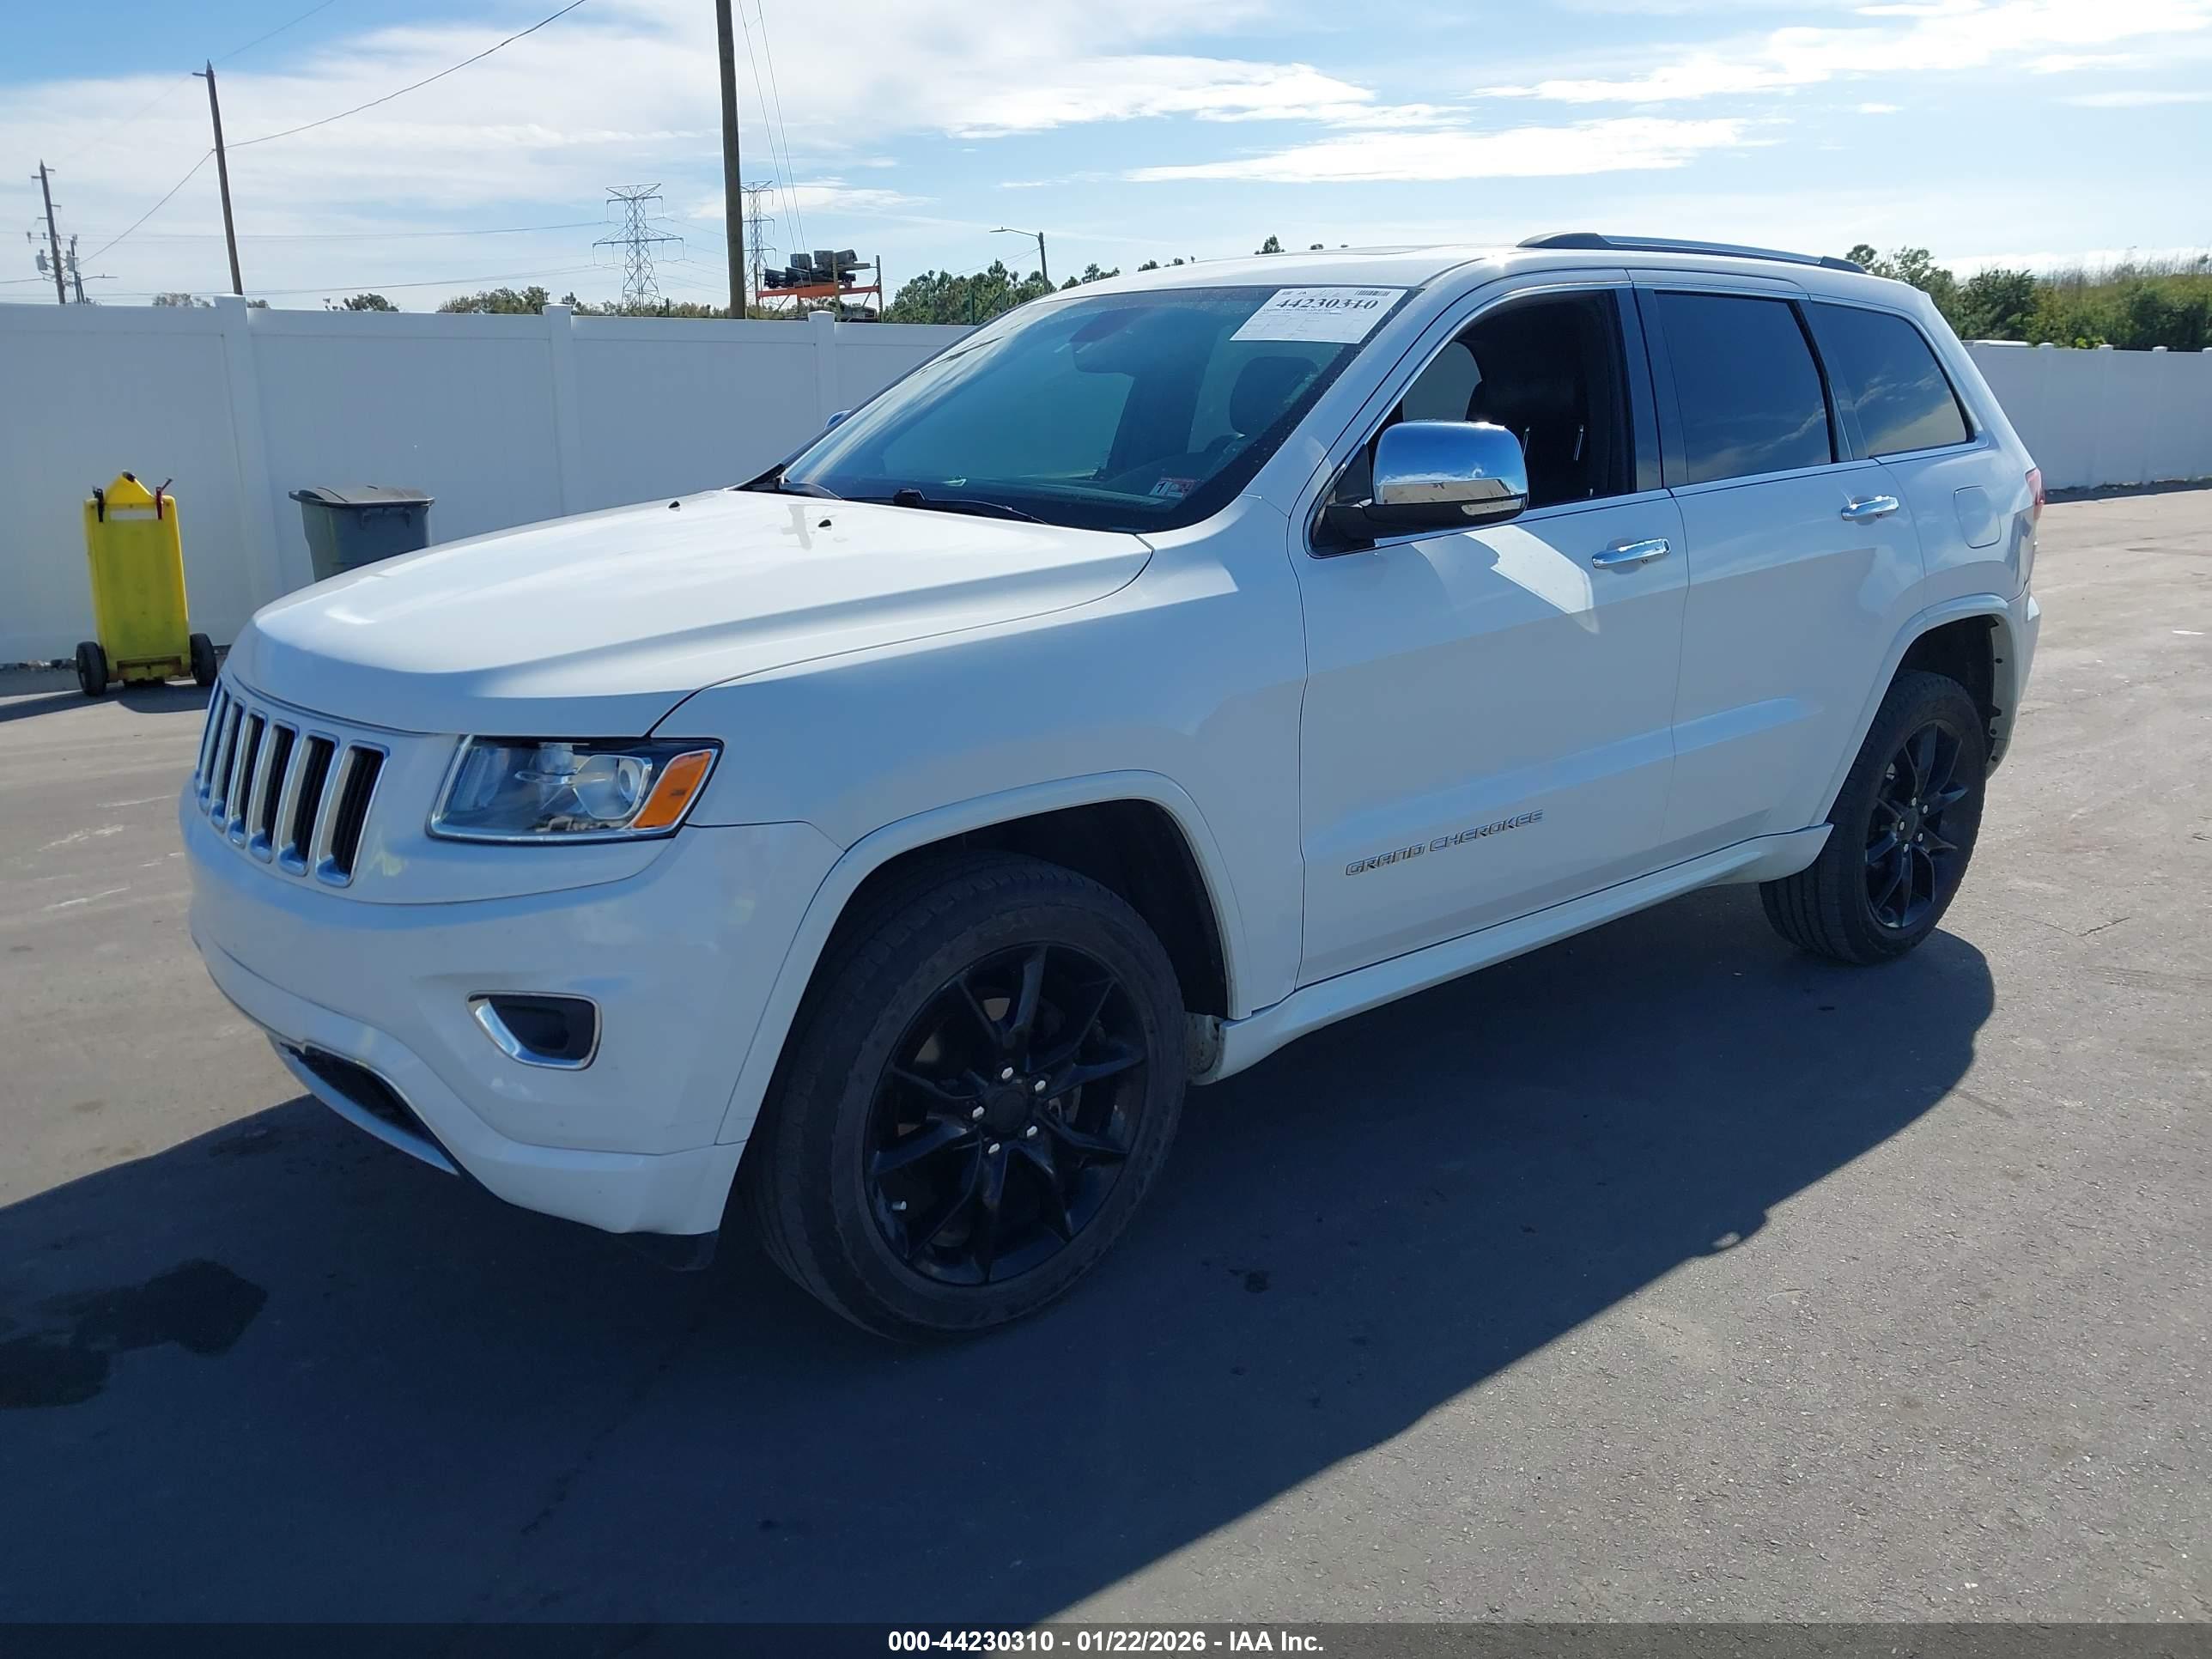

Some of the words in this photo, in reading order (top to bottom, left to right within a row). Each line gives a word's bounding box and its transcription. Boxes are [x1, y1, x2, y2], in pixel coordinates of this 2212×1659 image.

[1275, 298, 1379, 310] 44230310
[1346, 843, 1425, 876] GRAND
[1429, 809, 1544, 852] CHEROKEE
